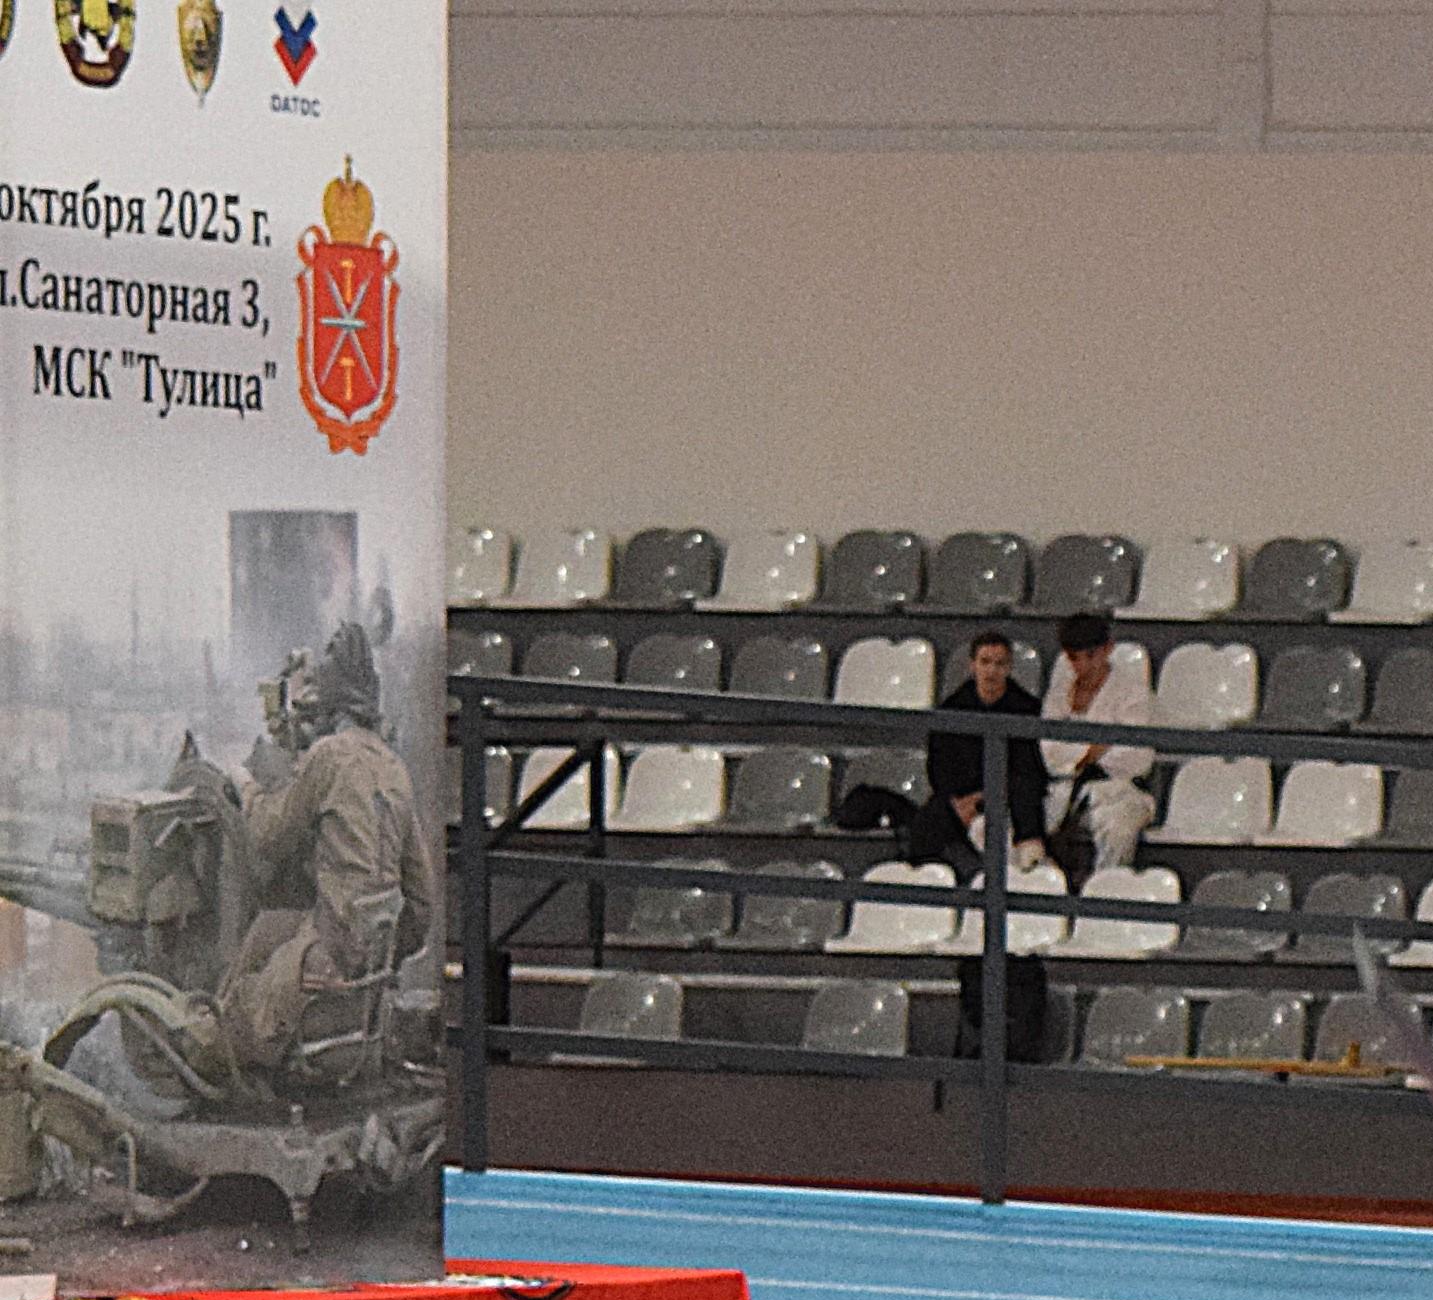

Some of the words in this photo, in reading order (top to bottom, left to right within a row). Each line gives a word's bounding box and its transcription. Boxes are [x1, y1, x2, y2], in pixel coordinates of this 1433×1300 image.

[0, 179, 147, 239] октября
[156, 187, 242, 244] 2025
[252, 208, 271, 247] г.
[241, 278, 270, 338] 3,
[33, 344, 112, 400] МСК
[121, 350, 277, 420] "Тулица"
